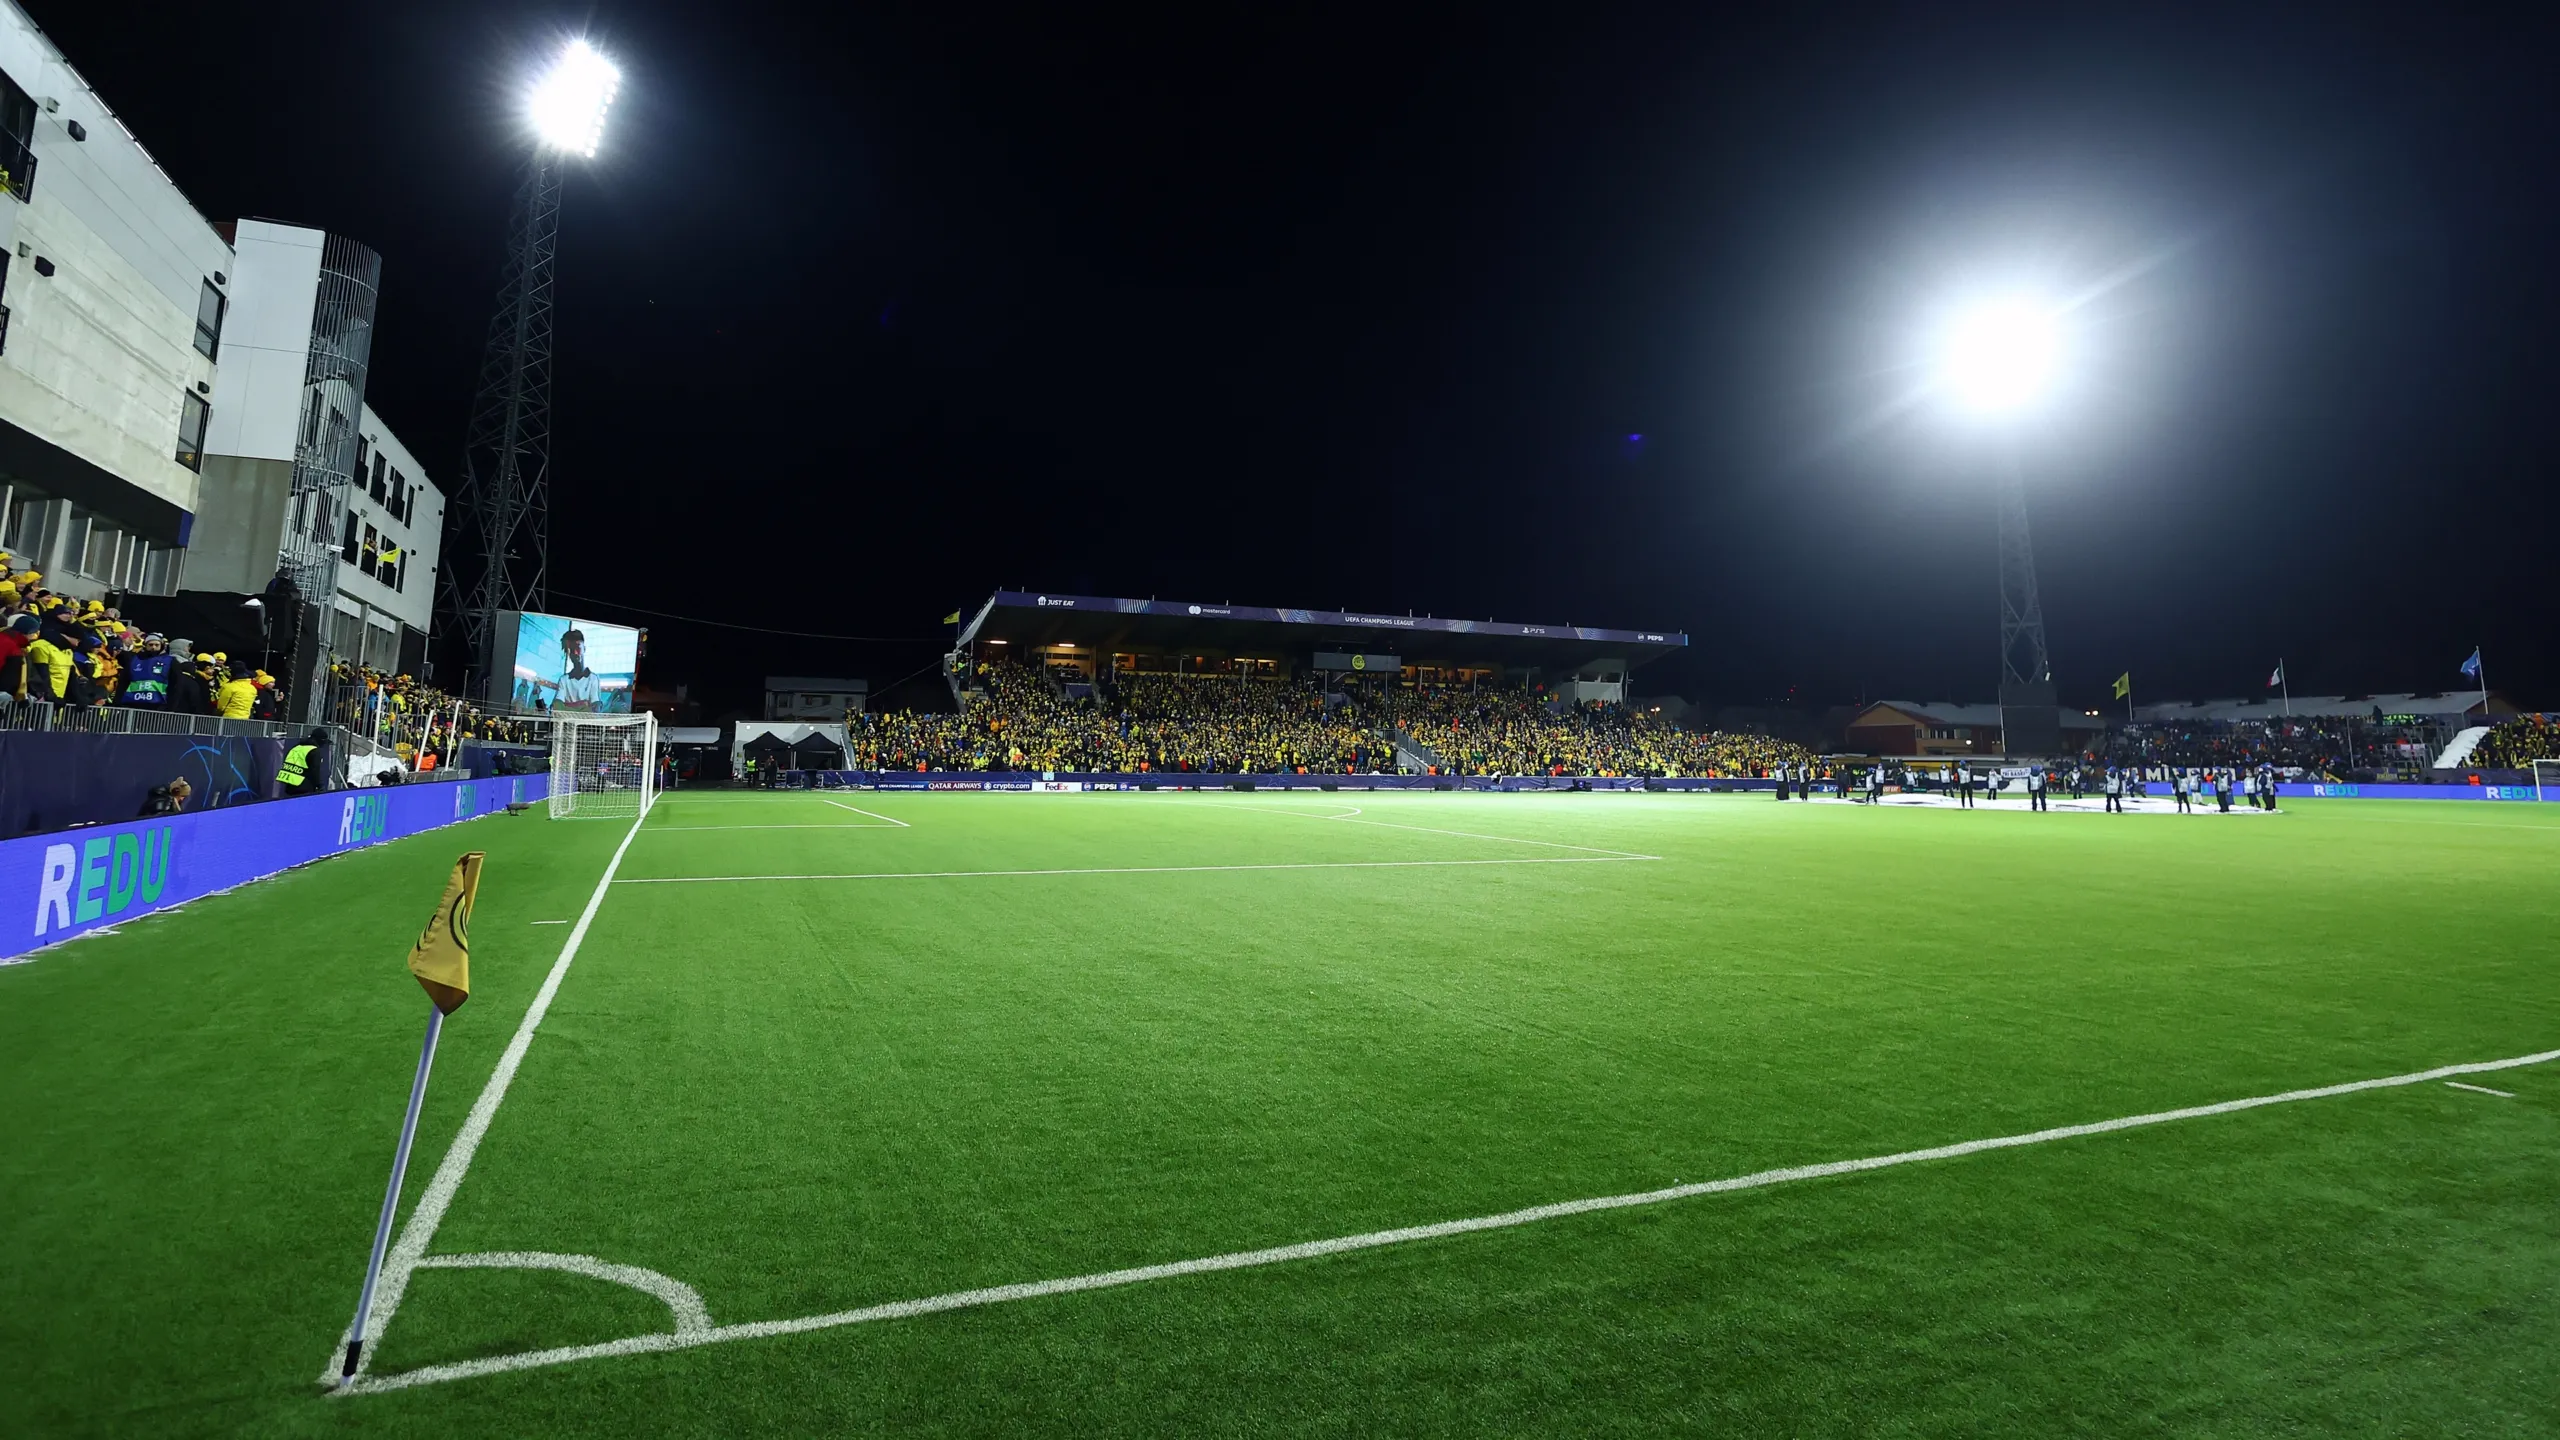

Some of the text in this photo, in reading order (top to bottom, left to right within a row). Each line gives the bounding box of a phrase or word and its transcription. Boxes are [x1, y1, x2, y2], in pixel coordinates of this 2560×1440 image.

[1360, 617, 1393, 625] CHAMPIONS
[1393, 619, 1415, 627] LEAGUE
[134, 692, 153, 701] 048
[928, 782, 952, 790] QATAR
[992, 782, 1030, 790] crypto.com
[1044, 782, 1069, 791] FedEx
[2313, 784, 2359, 797] REDU
[338, 793, 388, 845] REDU
[34, 826, 172, 937] REDU
